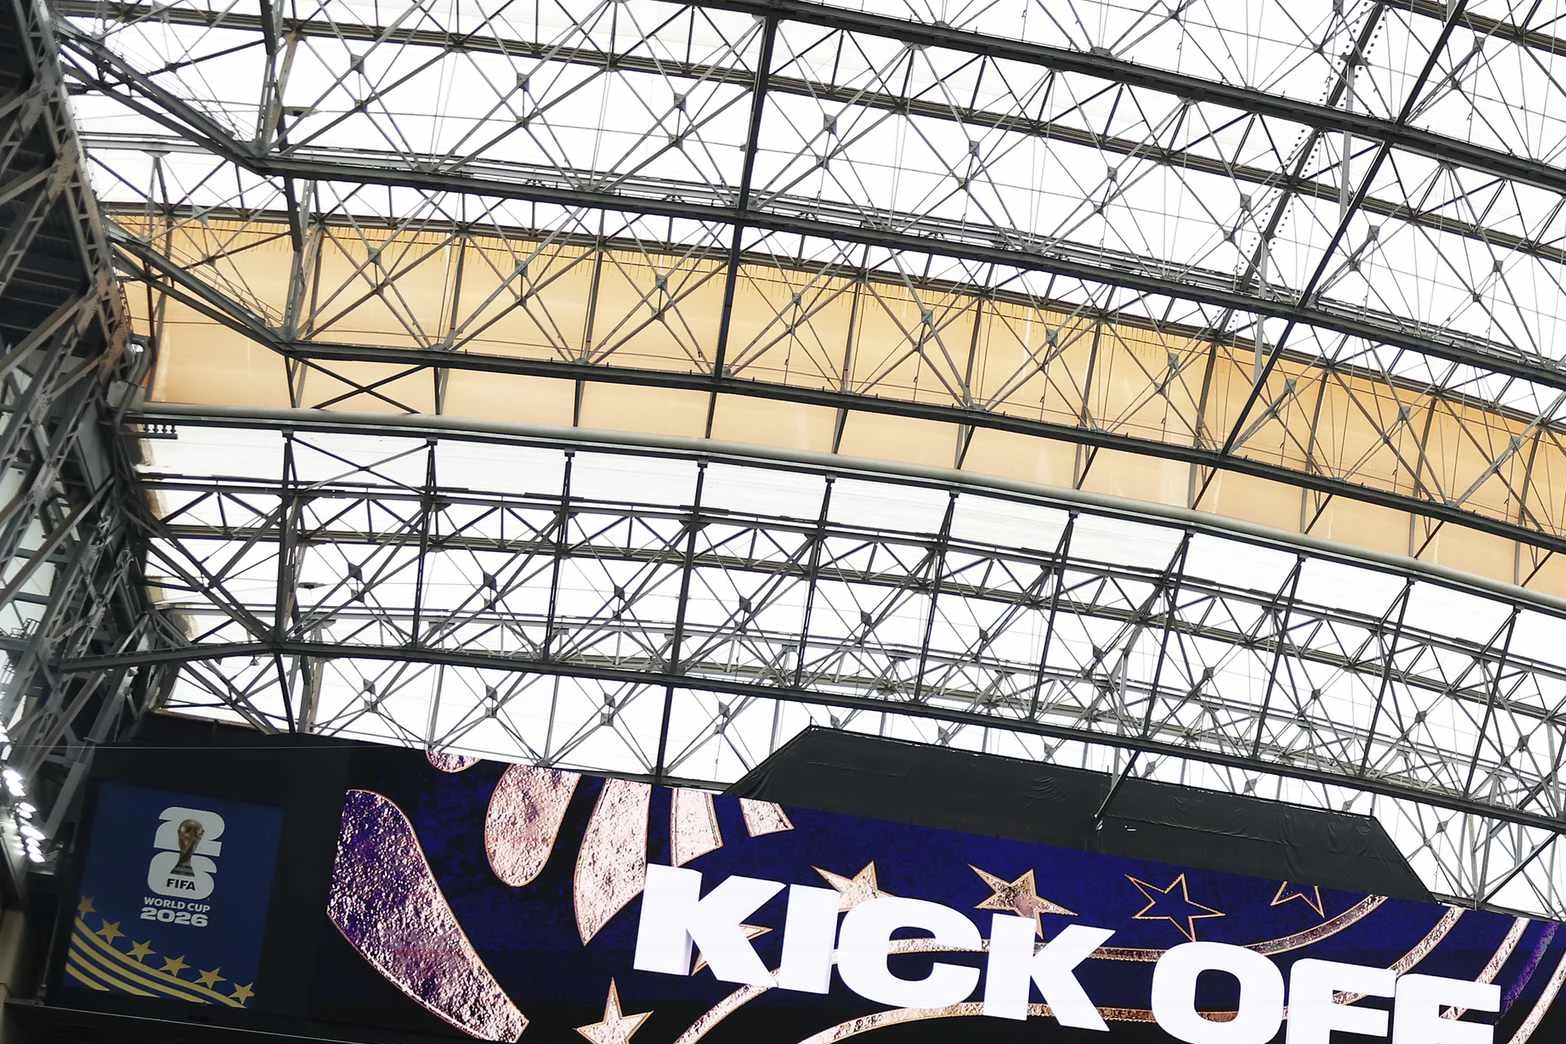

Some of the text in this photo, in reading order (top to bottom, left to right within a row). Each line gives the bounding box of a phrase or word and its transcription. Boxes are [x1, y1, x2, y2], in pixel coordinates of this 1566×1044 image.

[166, 878, 196, 891] FIFA
[144, 896, 210, 913] WORLD CUP
[140, 906, 209, 928] 2026
[634, 863, 1116, 1032] KICK
